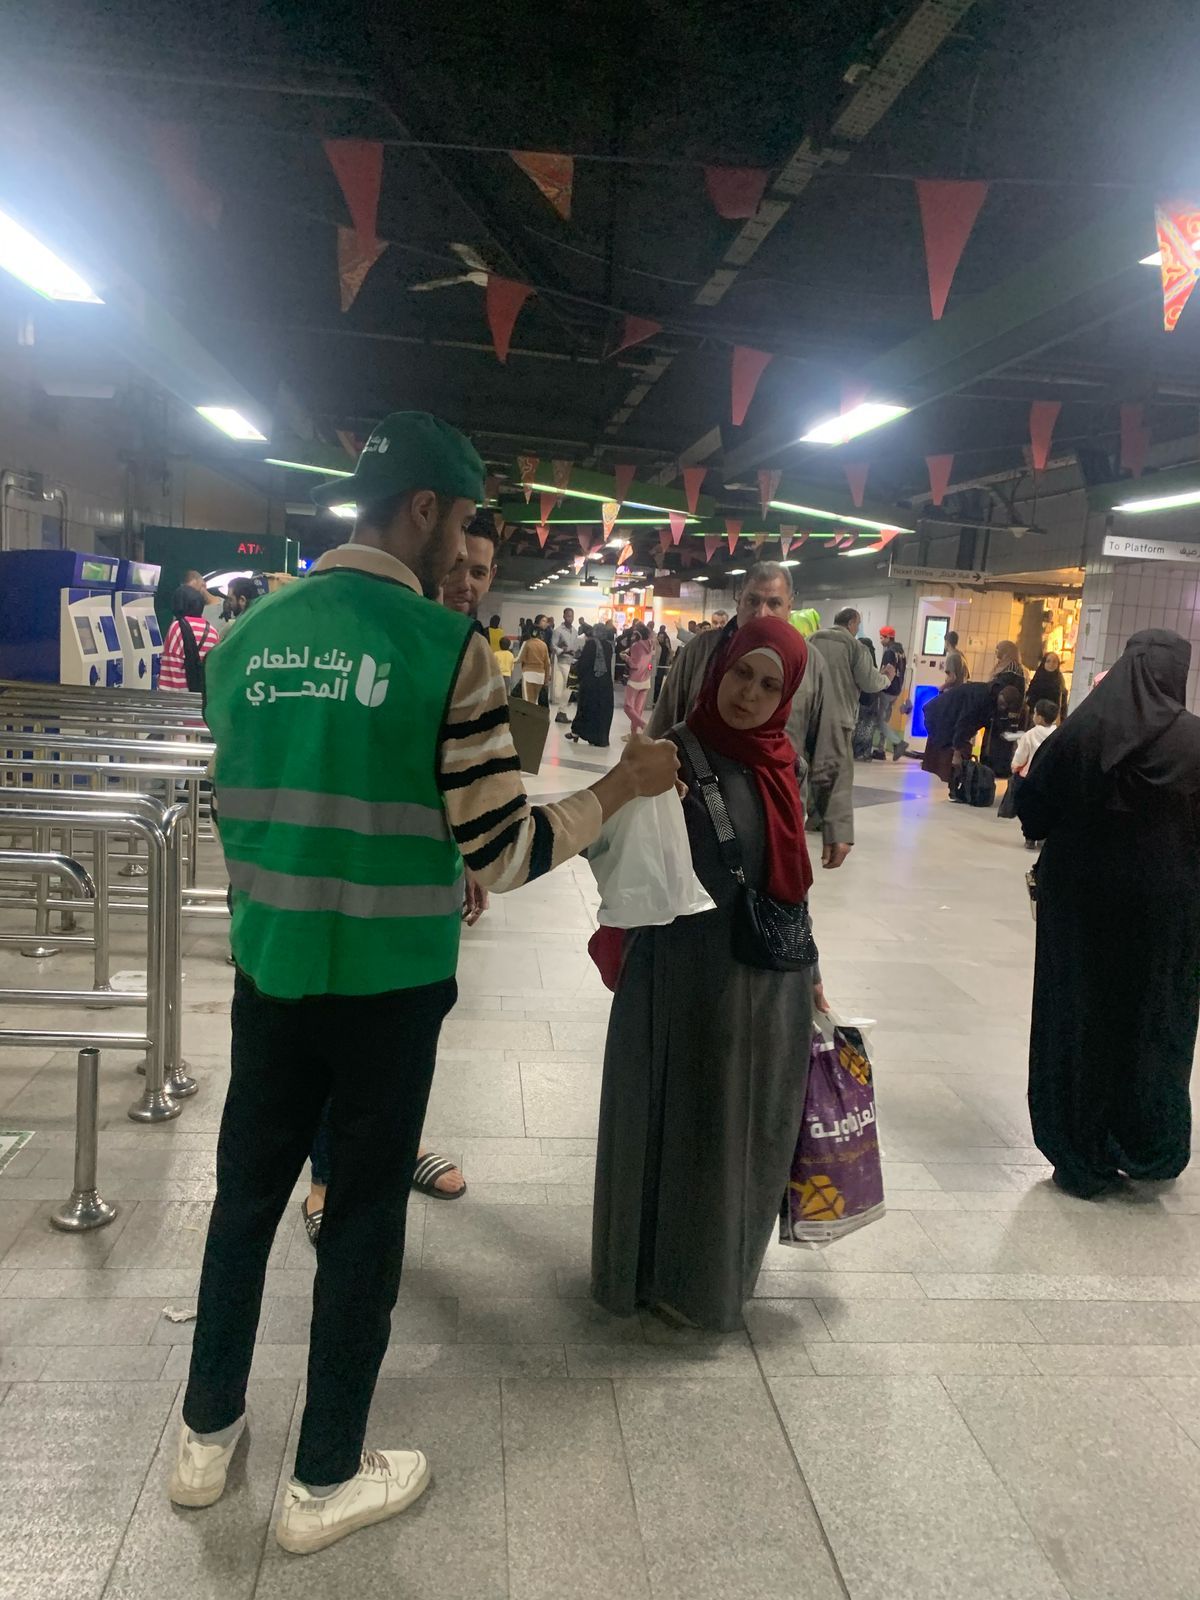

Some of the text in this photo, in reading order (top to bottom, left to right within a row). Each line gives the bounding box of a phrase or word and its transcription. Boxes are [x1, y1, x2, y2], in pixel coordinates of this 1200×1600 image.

[1109, 541, 1165, 554] To Platform
[314, 649, 353, 677] بنك
